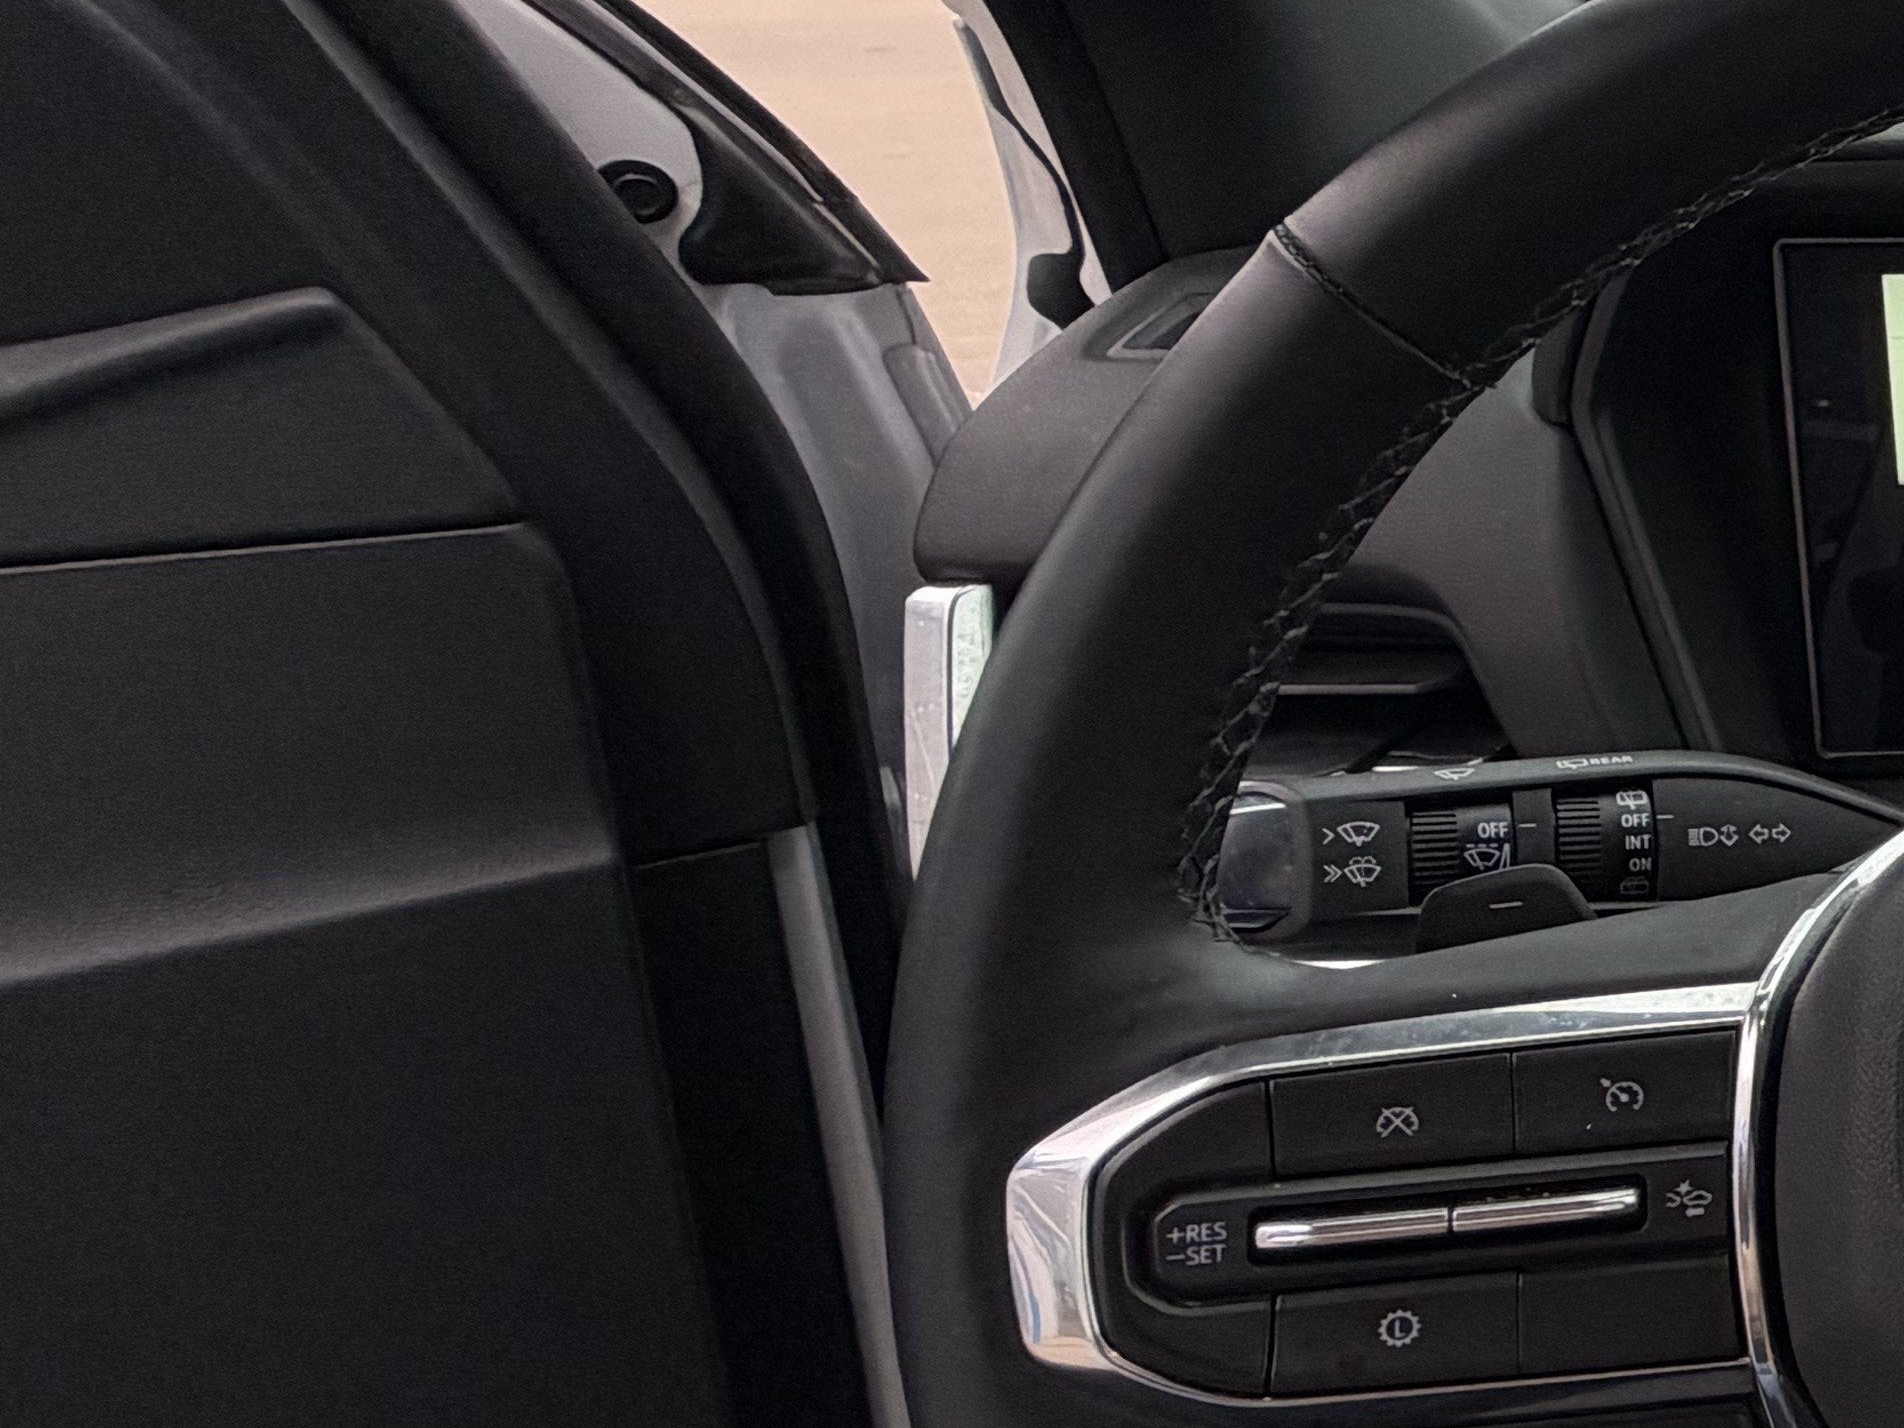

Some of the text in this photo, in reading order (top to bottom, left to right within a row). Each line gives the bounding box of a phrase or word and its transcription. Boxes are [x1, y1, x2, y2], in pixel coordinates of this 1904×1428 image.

[1588, 754, 1633, 767] REAR
[1620, 810, 1651, 830] OFF
[1476, 820, 1509, 840] OFF
[1624, 834, 1652, 851] INT
[1628, 856, 1653, 872] ON
